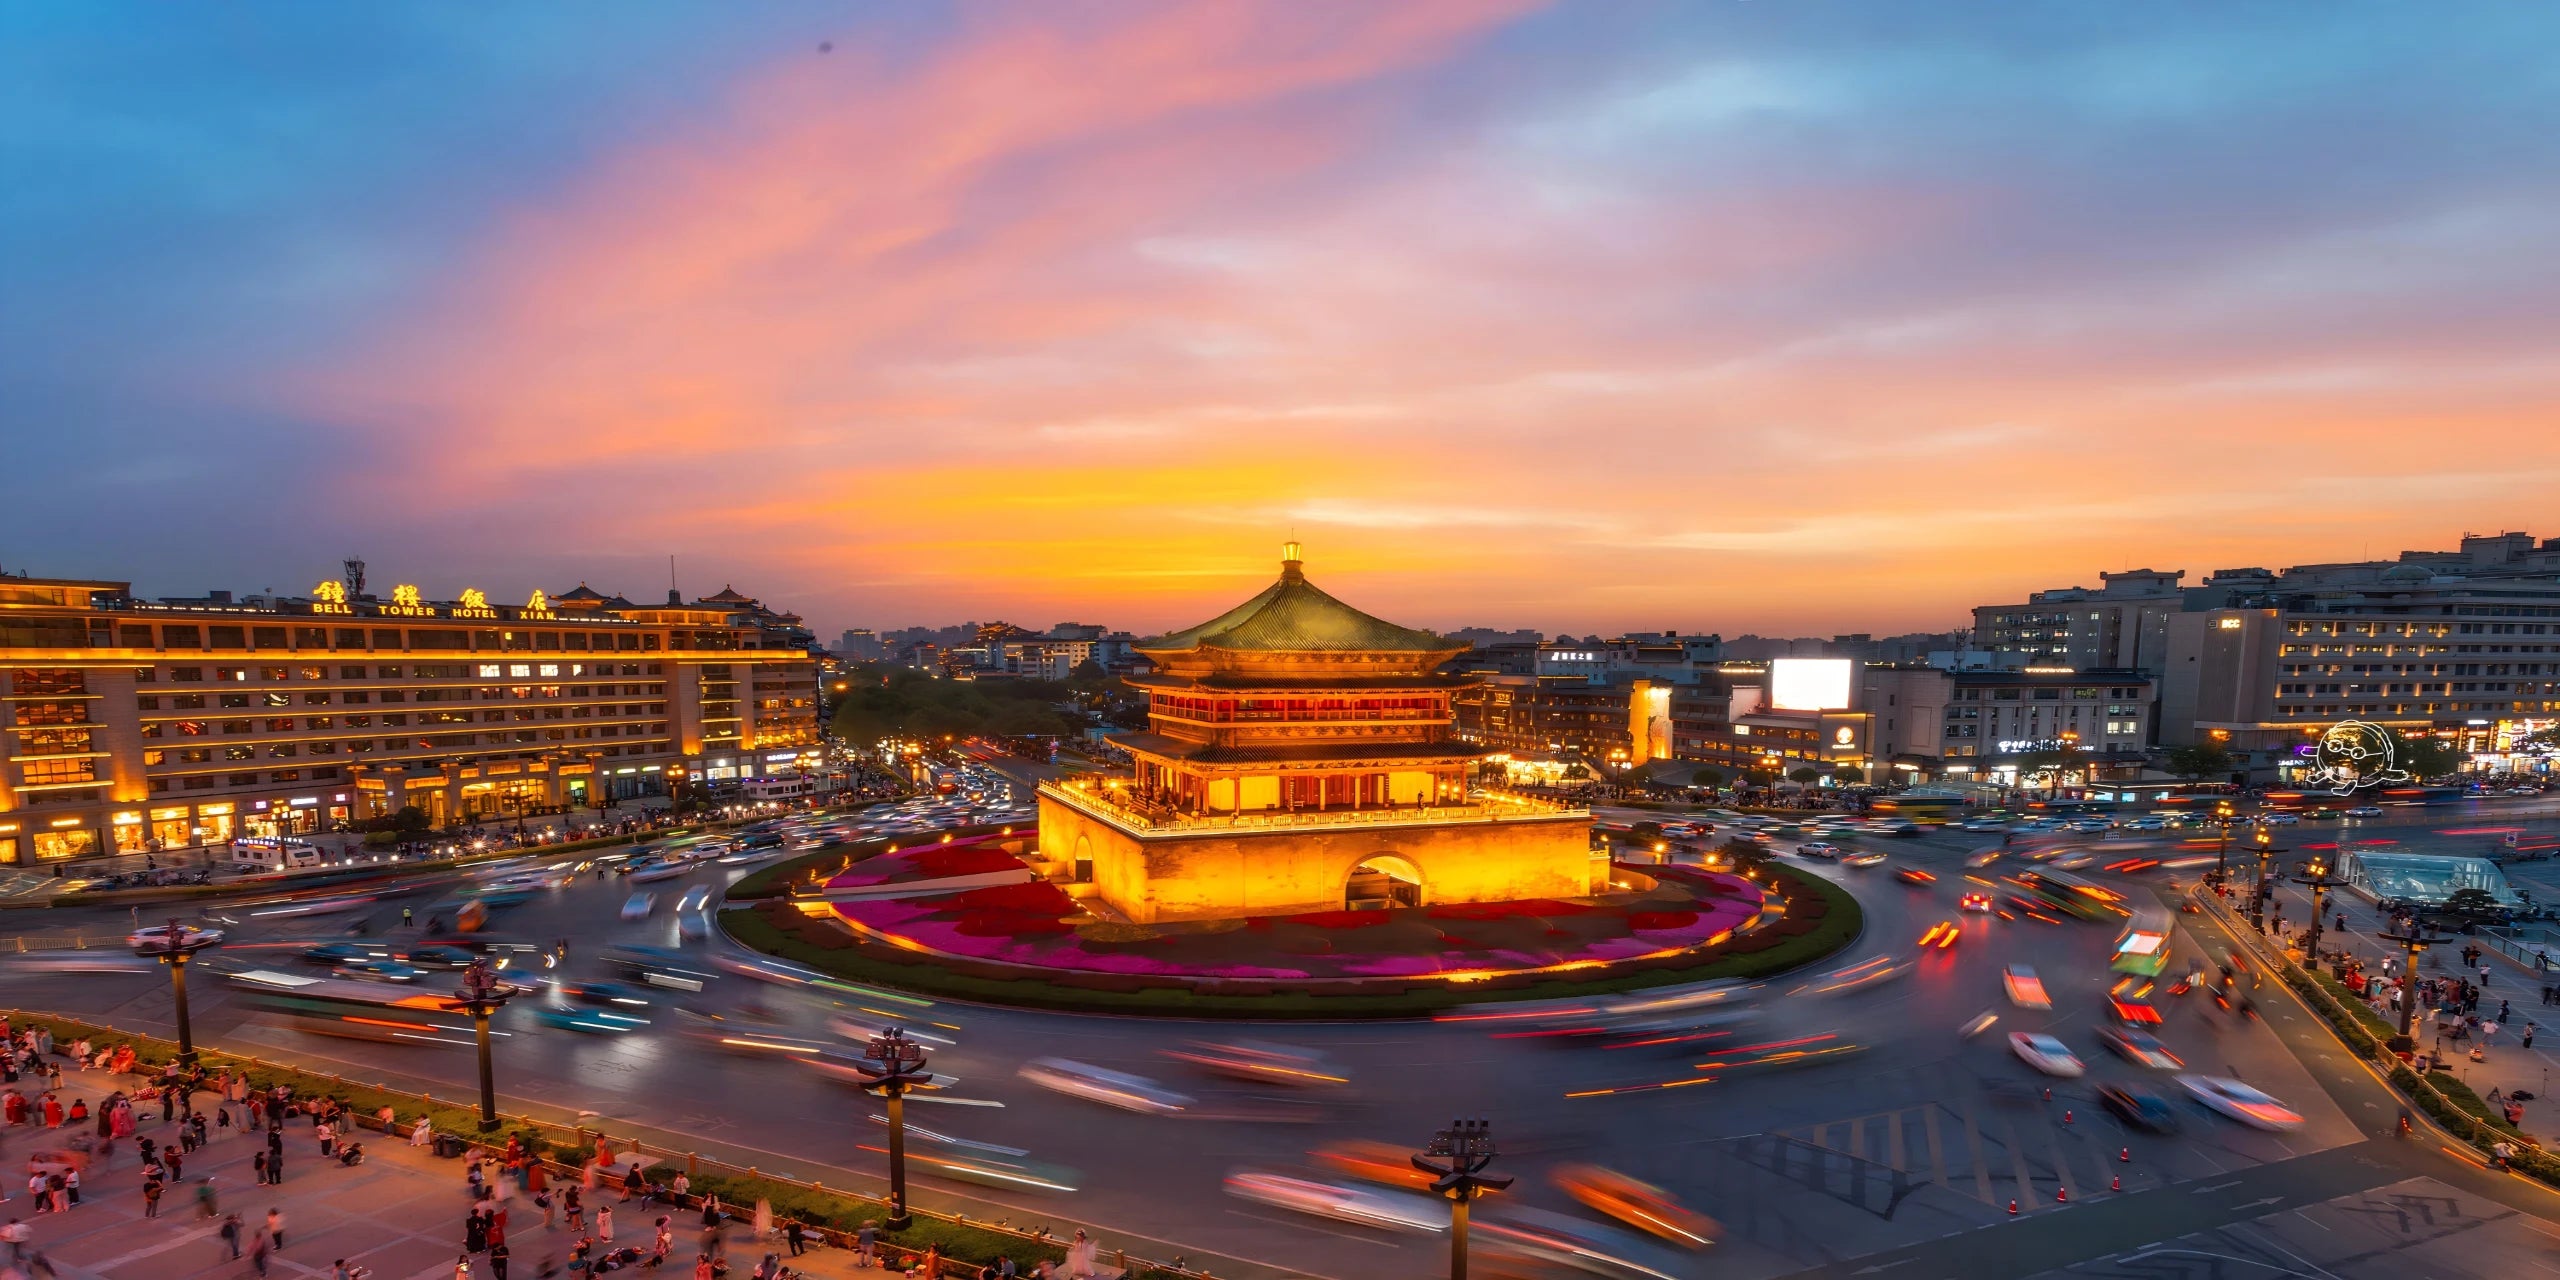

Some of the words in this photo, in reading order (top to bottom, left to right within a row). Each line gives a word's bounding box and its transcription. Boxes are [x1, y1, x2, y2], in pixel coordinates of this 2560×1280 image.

[313, 603, 352, 614] BELL
[378, 605, 435, 616] TOWER
[452, 608, 498, 618] HOTEL
[520, 611, 555, 620] XIAN
